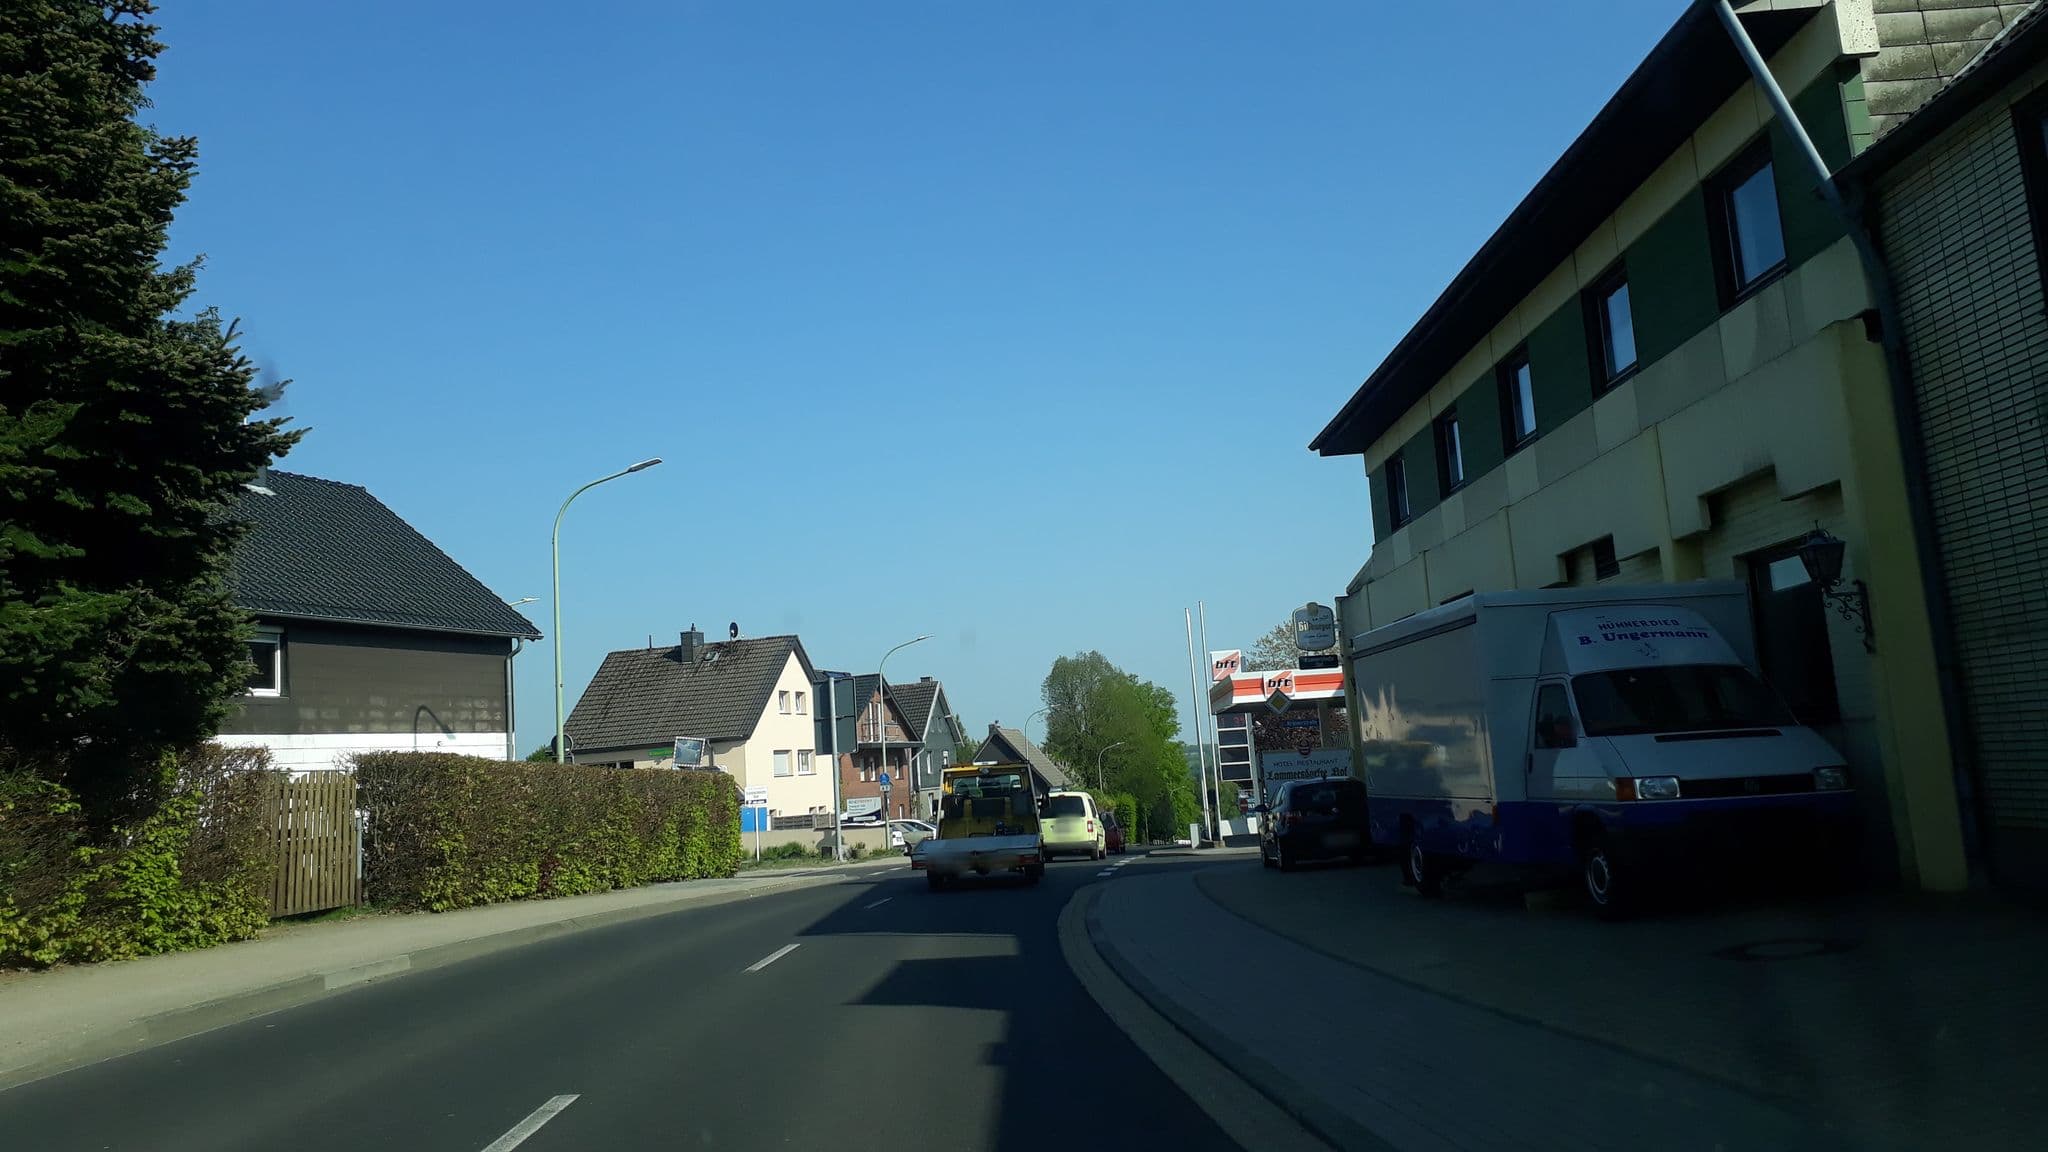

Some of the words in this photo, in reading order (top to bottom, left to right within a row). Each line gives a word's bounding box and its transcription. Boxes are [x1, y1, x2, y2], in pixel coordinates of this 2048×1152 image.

[1577, 635, 1597, 645] B.
[1602, 630, 1709, 641] Ungermann
[1216, 660, 1237, 669] bft
[1268, 678, 1292, 688] bft
